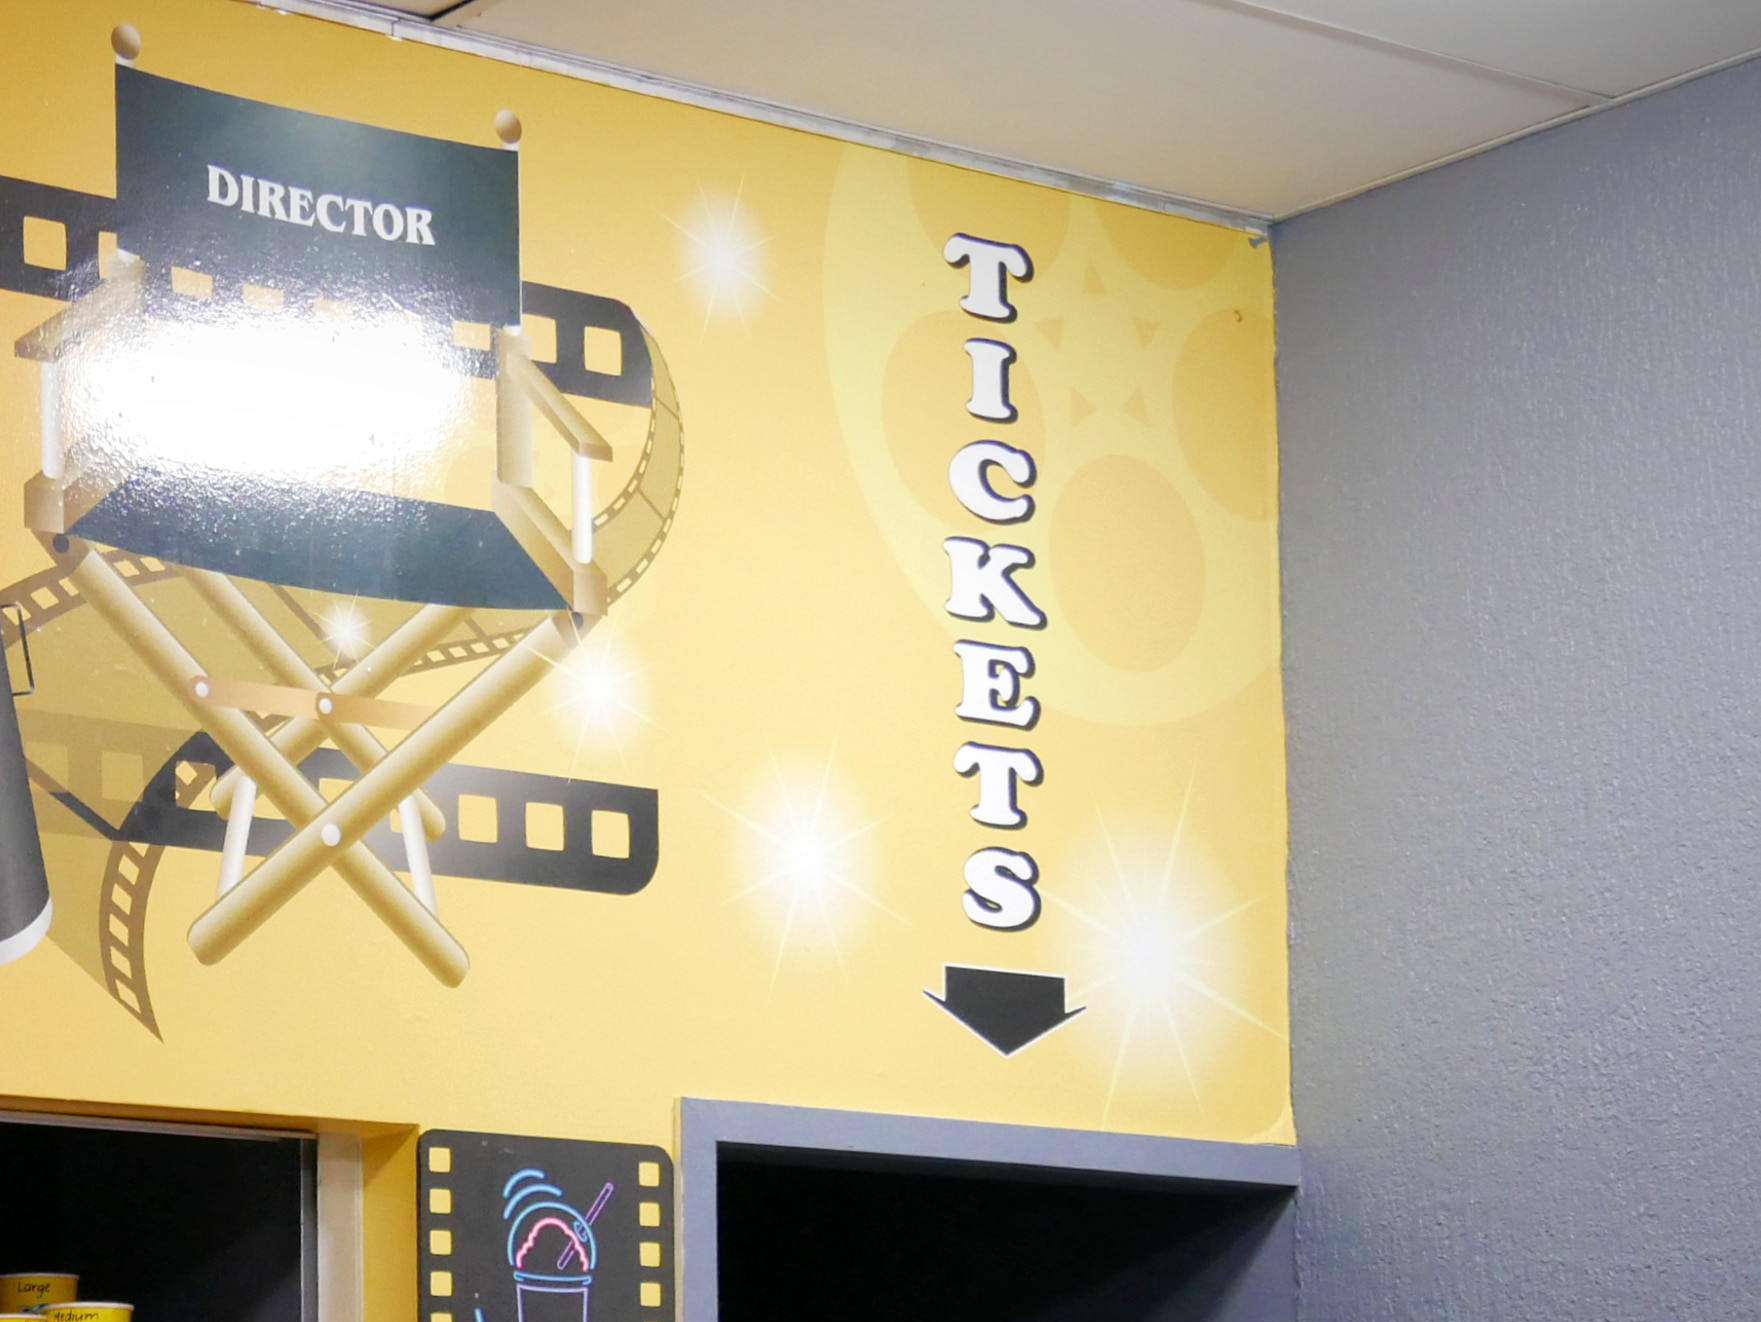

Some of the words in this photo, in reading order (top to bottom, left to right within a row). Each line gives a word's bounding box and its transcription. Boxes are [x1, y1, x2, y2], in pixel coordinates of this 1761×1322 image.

[207, 164, 435, 245] DIRECTOR
[943, 231, 1047, 933] TICKETS
[18, 1281, 51, 1298] Large
[53, 1309, 99, 1322] Medium
